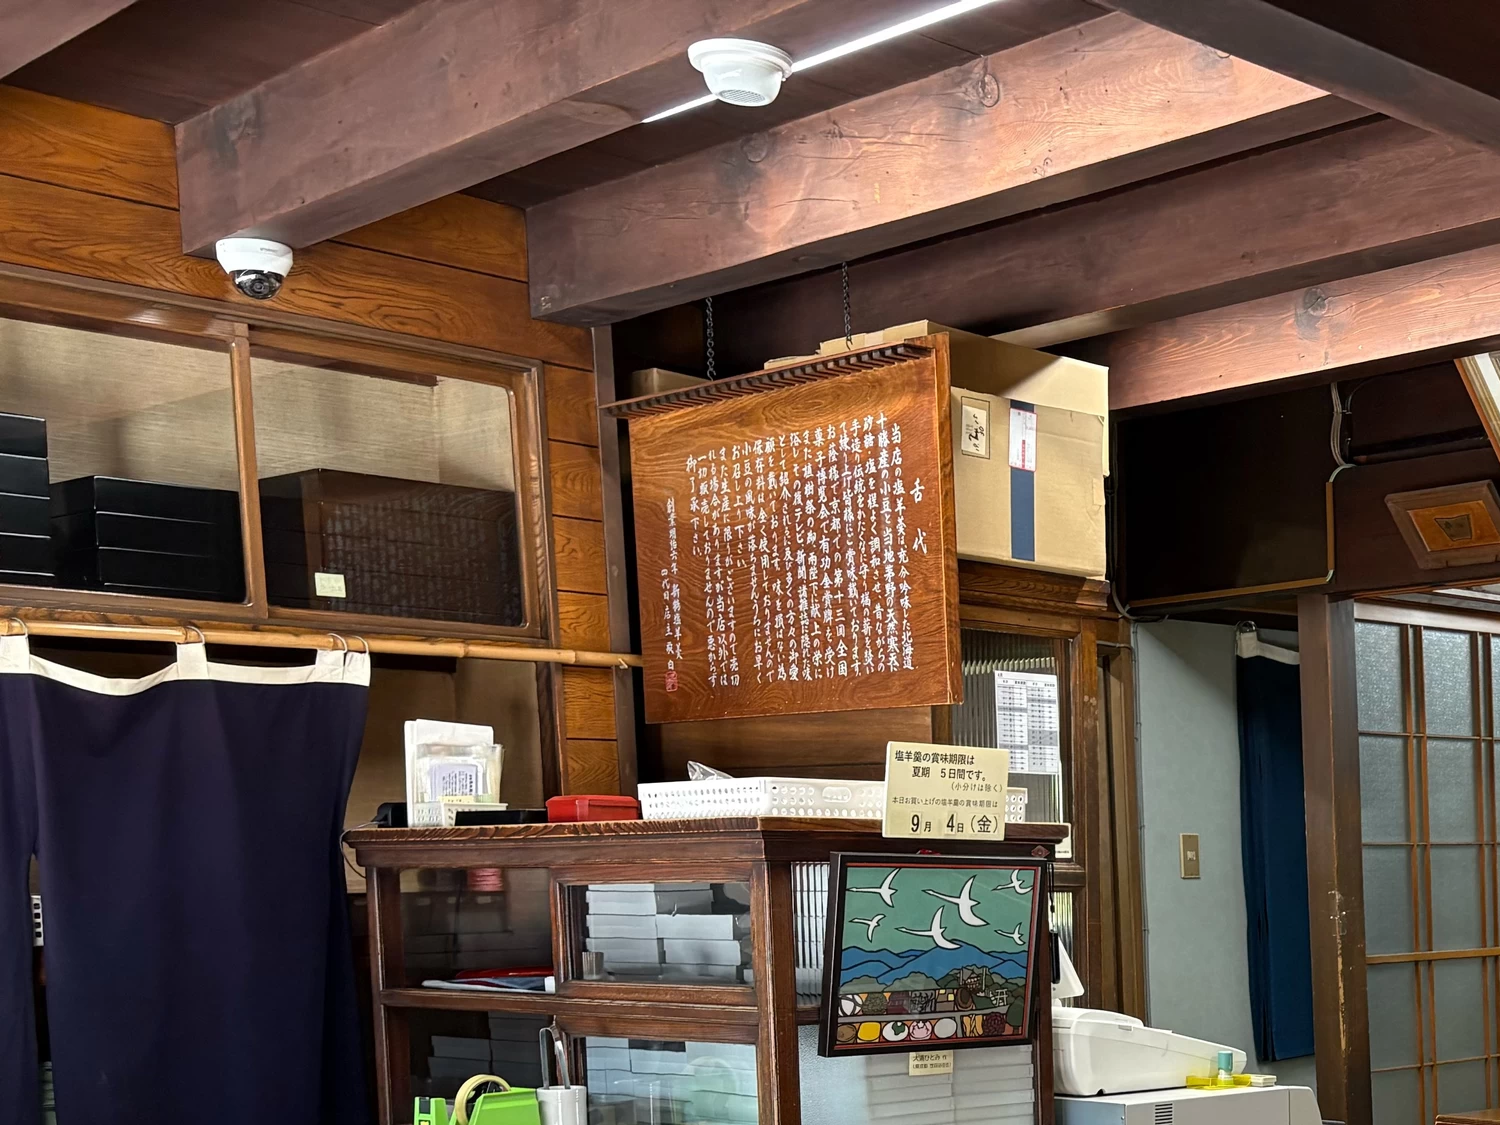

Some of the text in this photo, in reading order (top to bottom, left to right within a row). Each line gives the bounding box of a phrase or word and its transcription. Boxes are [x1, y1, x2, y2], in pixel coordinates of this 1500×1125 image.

[895, 750, 975, 766] 塩羊羹の賞味期限は
[912, 766, 930, 778] 夏期
